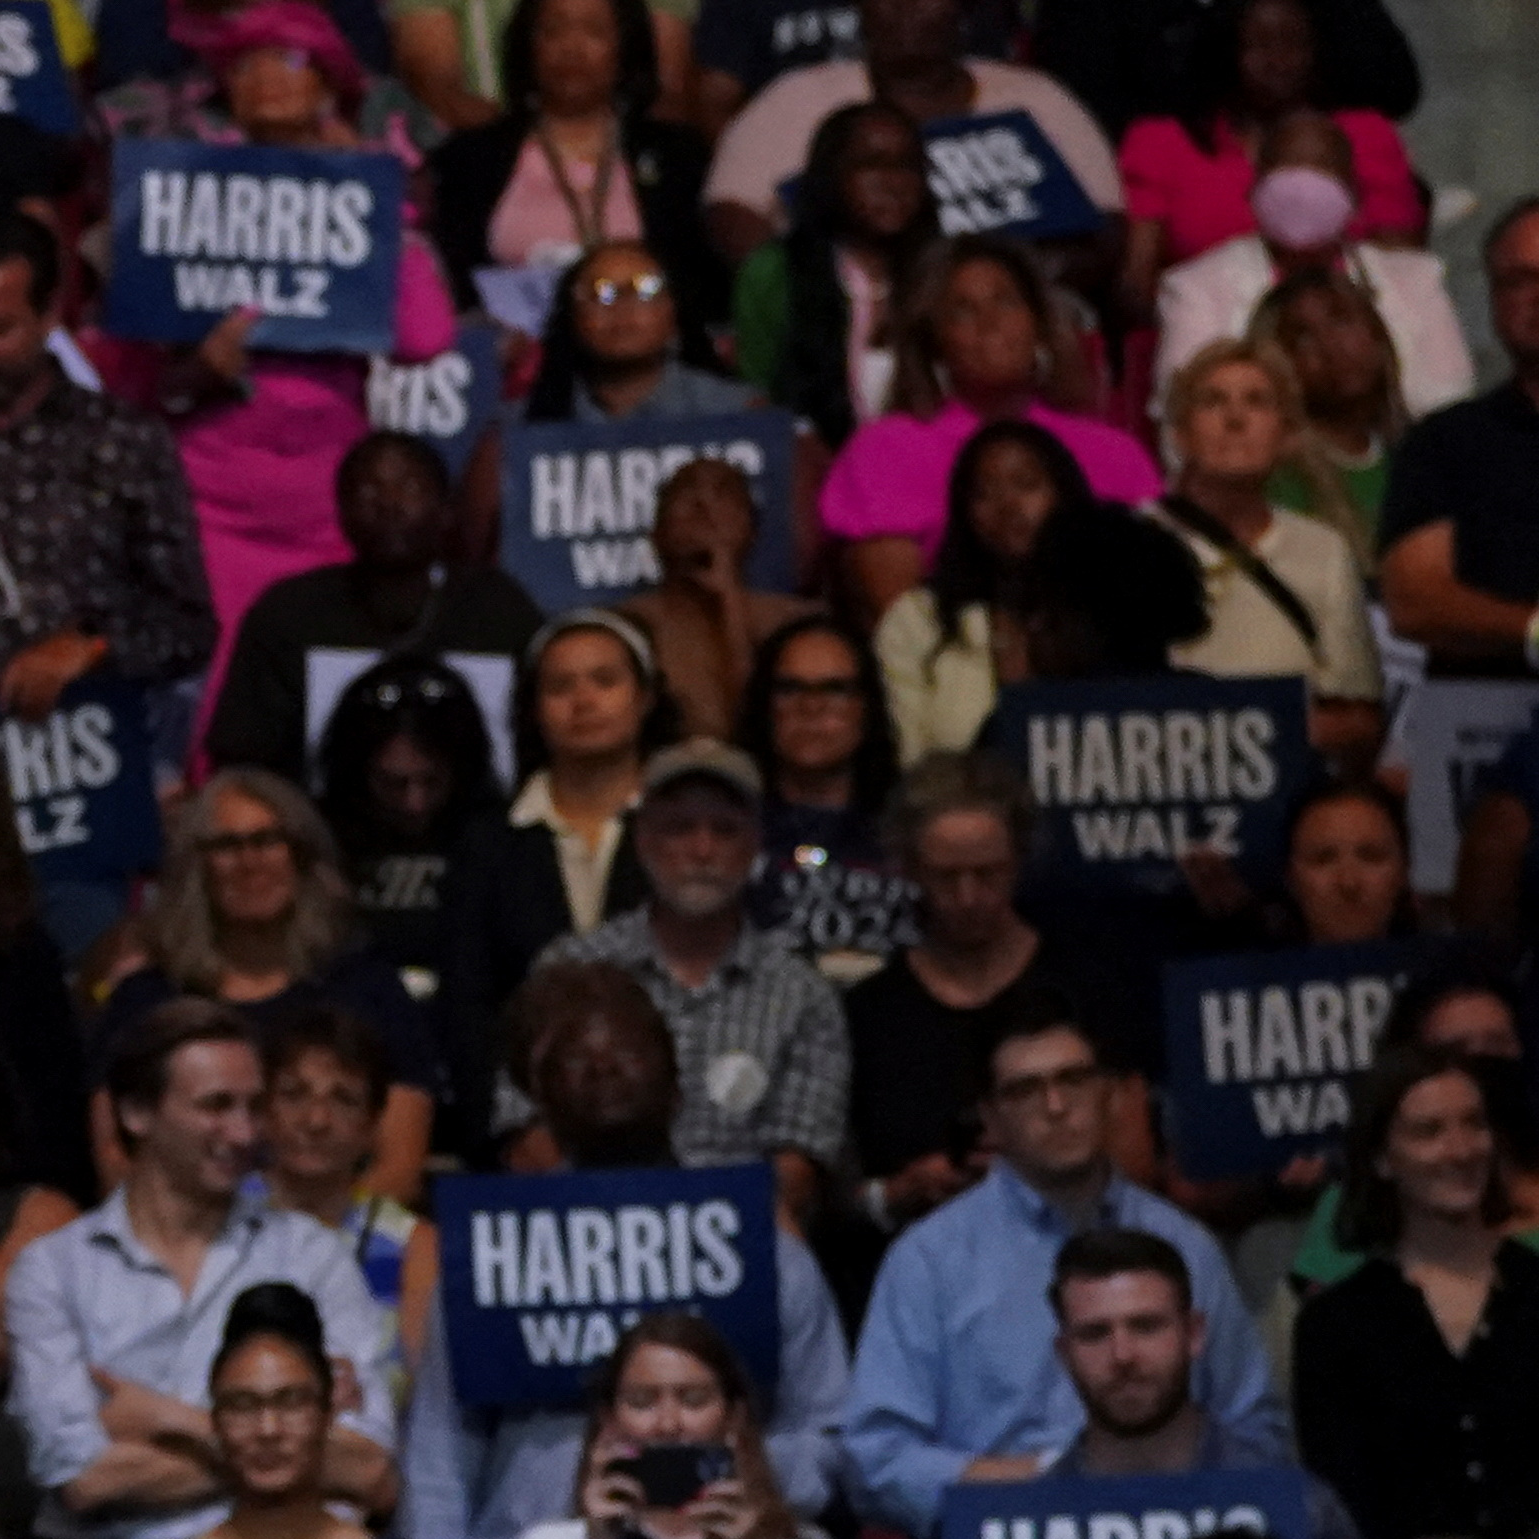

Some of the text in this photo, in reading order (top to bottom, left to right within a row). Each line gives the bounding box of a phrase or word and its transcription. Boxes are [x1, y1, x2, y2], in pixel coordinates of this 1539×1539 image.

[139, 169, 374, 270] HARRIS
[172, 263, 331, 318] WALZ
[570, 538, 662, 590] WA
[1027, 708, 1276, 803] HARRIS
[15, 794, 94, 853] LZ
[1074, 806, 1243, 862] WALZ
[1200, 972, 1410, 1086] HARR
[1252, 1085, 1351, 1138] WA
[471, 1200, 745, 1308] HARRIS
[520, 1311, 634, 1366] WA
